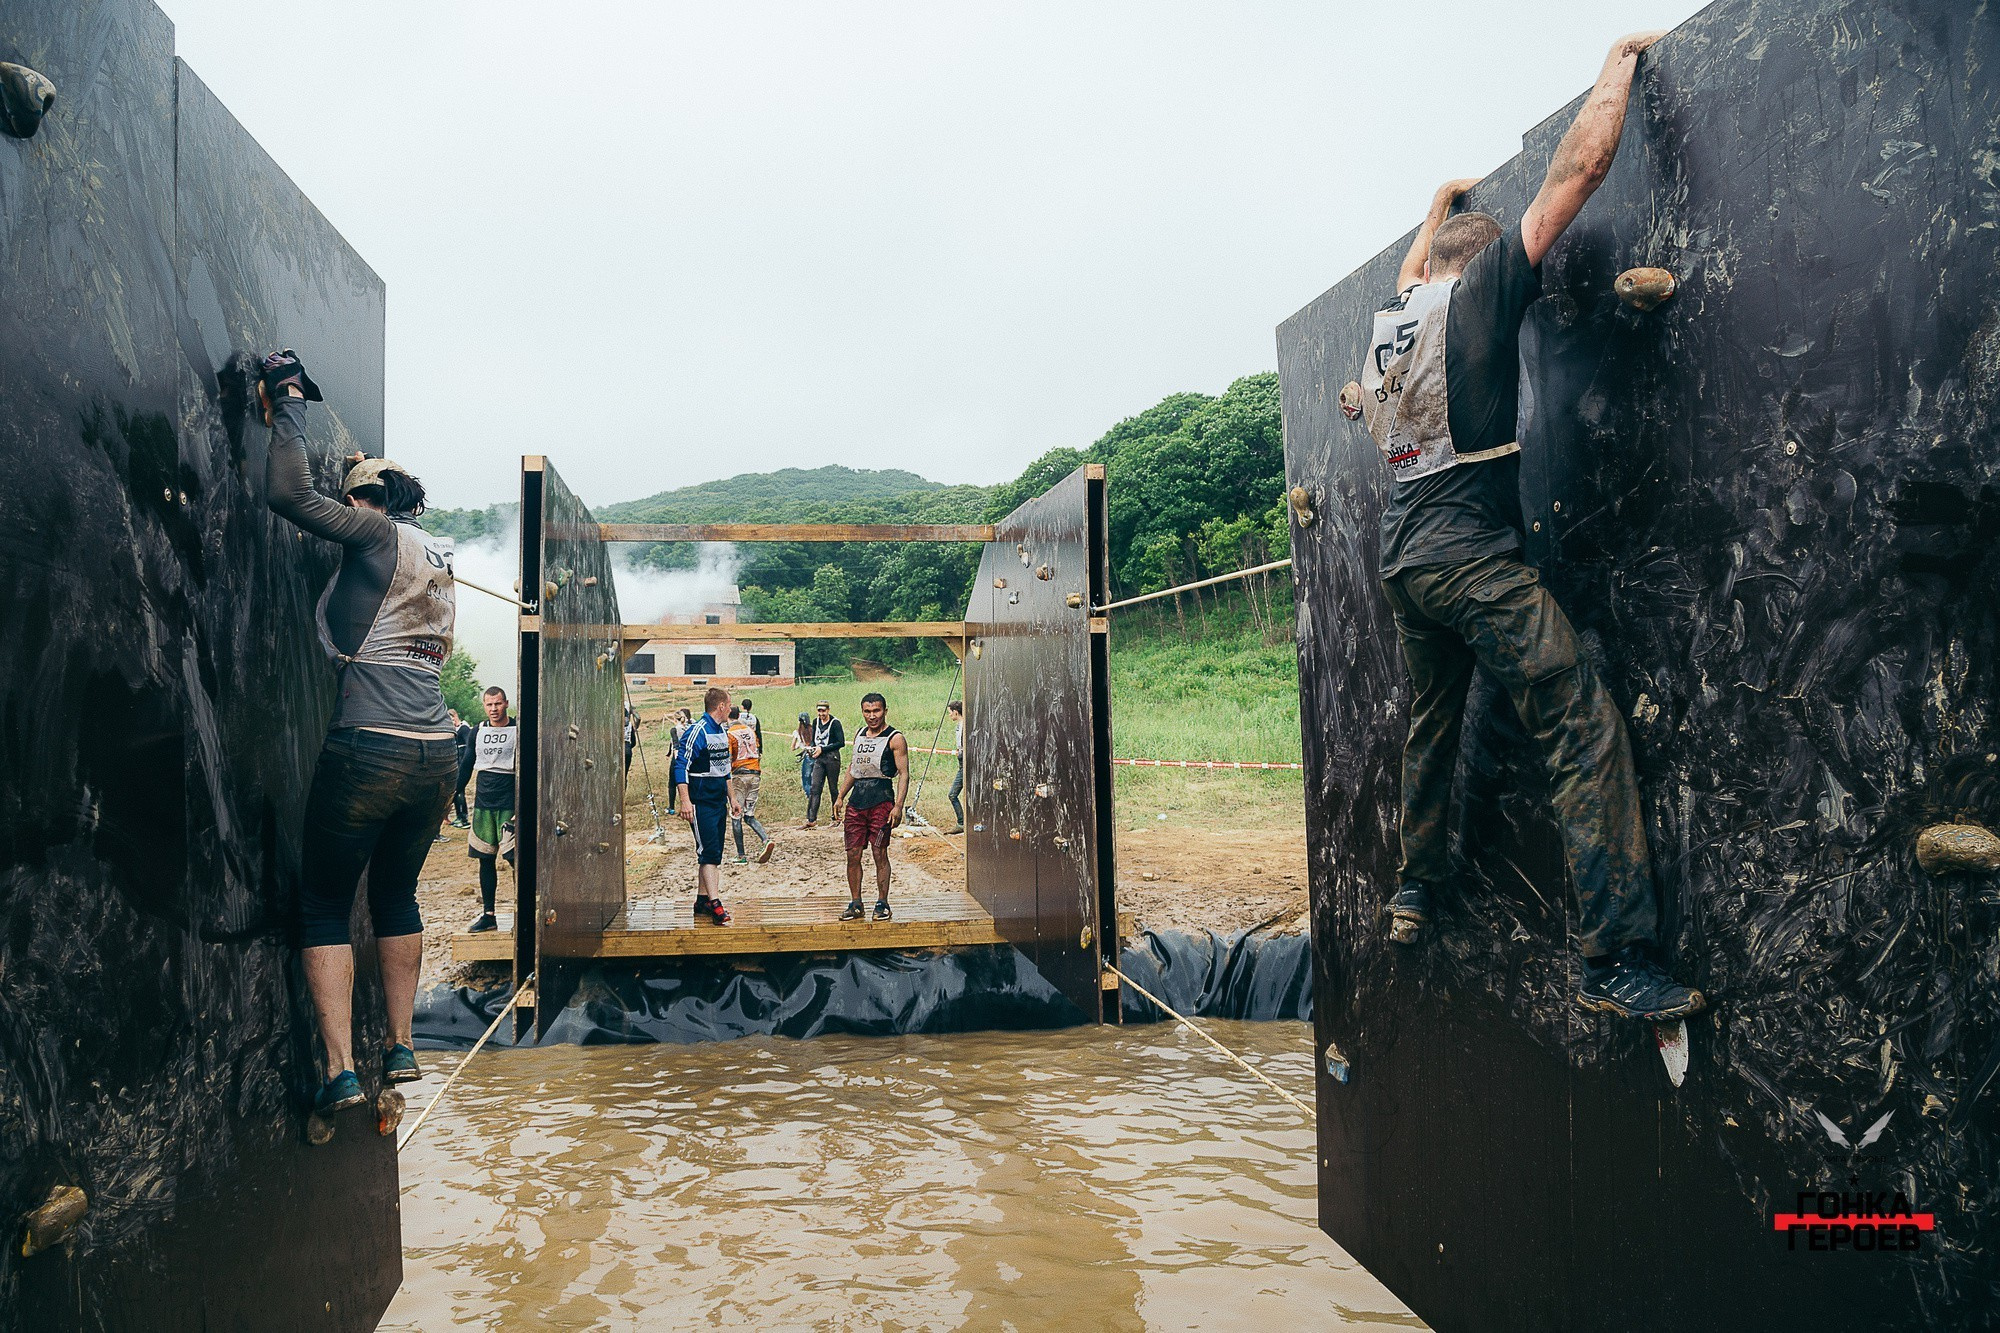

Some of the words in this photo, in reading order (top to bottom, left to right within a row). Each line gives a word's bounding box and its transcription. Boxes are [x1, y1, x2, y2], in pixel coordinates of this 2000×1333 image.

[415, 640, 442, 654] ГОНКА
[406, 650, 440, 666] ГЕРОЕВ
[483, 733, 508, 744] 030
[857, 743, 877, 753] 035
